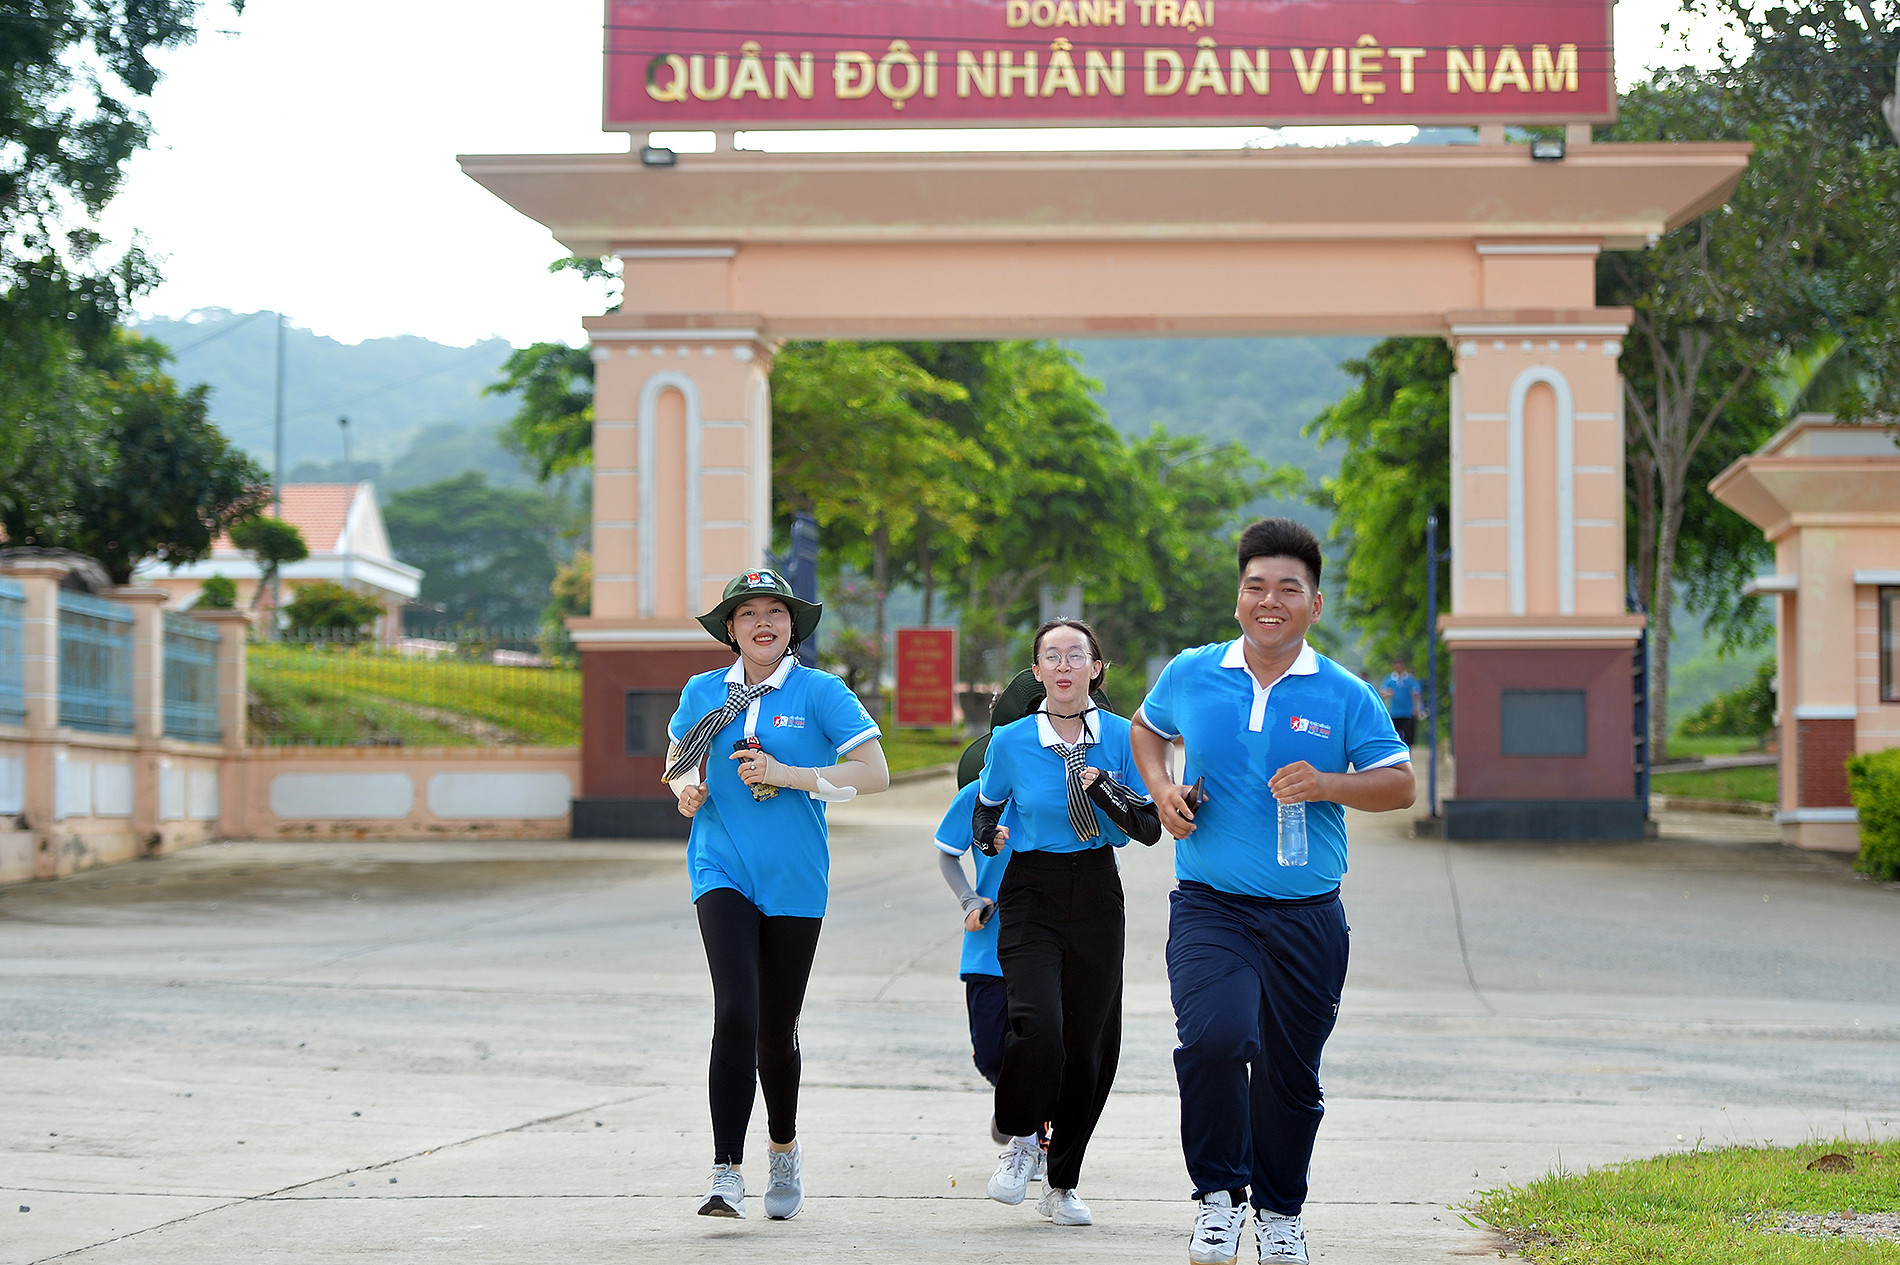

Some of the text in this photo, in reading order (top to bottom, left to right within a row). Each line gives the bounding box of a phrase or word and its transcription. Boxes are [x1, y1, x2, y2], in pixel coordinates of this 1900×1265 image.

[1006, 0, 1215, 33] DOANH TRẠI
[645, 34, 1579, 110] QUÂN ĐỘI NHÂN DÂN VIỆT NAM
